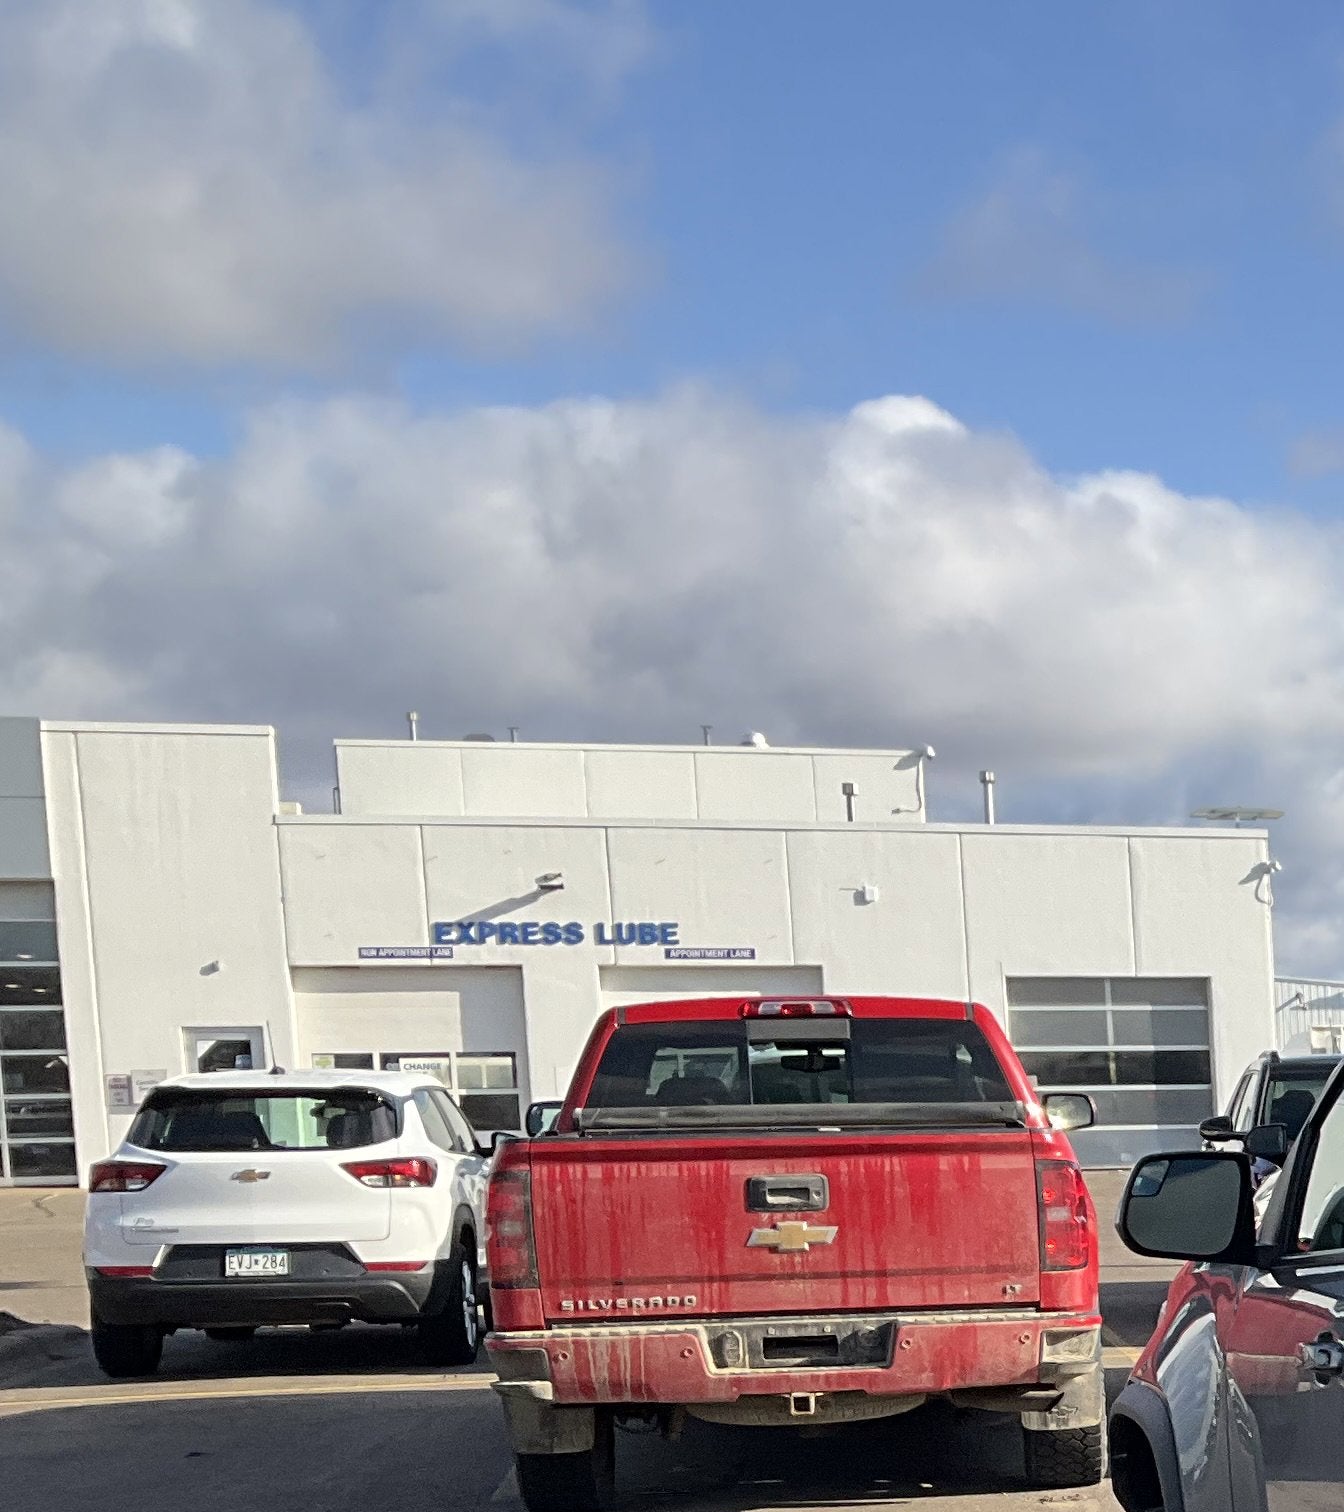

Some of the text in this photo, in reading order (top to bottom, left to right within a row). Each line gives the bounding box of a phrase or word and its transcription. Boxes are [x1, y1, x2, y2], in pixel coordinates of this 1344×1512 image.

[431, 921, 680, 946] EXPRESS LUBE
[378, 948, 431, 956] APPOINTMENT
[669, 949, 752, 958] APPOINTMENT LANE
[560, 1295, 697, 1312] SILVERADO
